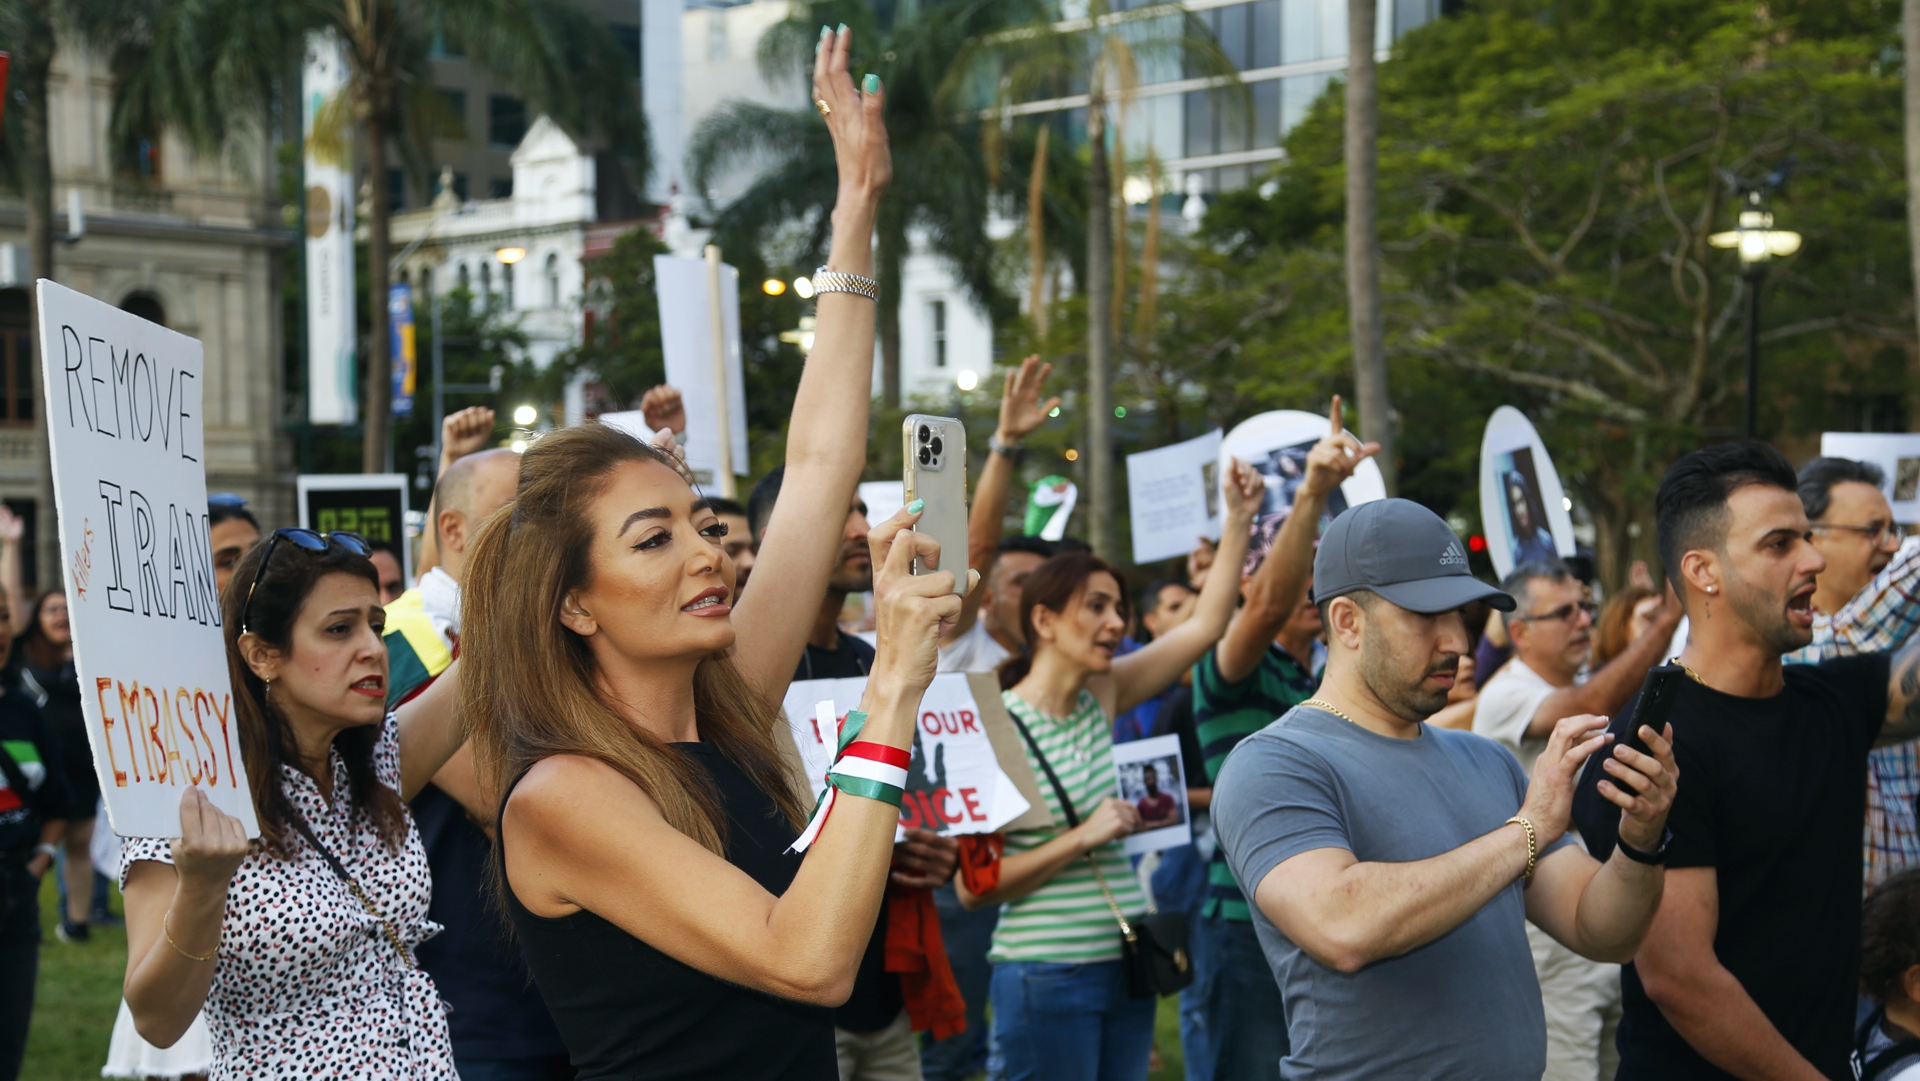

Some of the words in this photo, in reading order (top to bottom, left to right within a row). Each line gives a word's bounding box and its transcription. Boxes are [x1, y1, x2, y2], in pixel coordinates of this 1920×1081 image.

[62, 324, 197, 462] REMOVE
[99, 479, 221, 627] IRAN
[96, 677, 237, 788] EMBASSY
[898, 787, 987, 829] OICE
